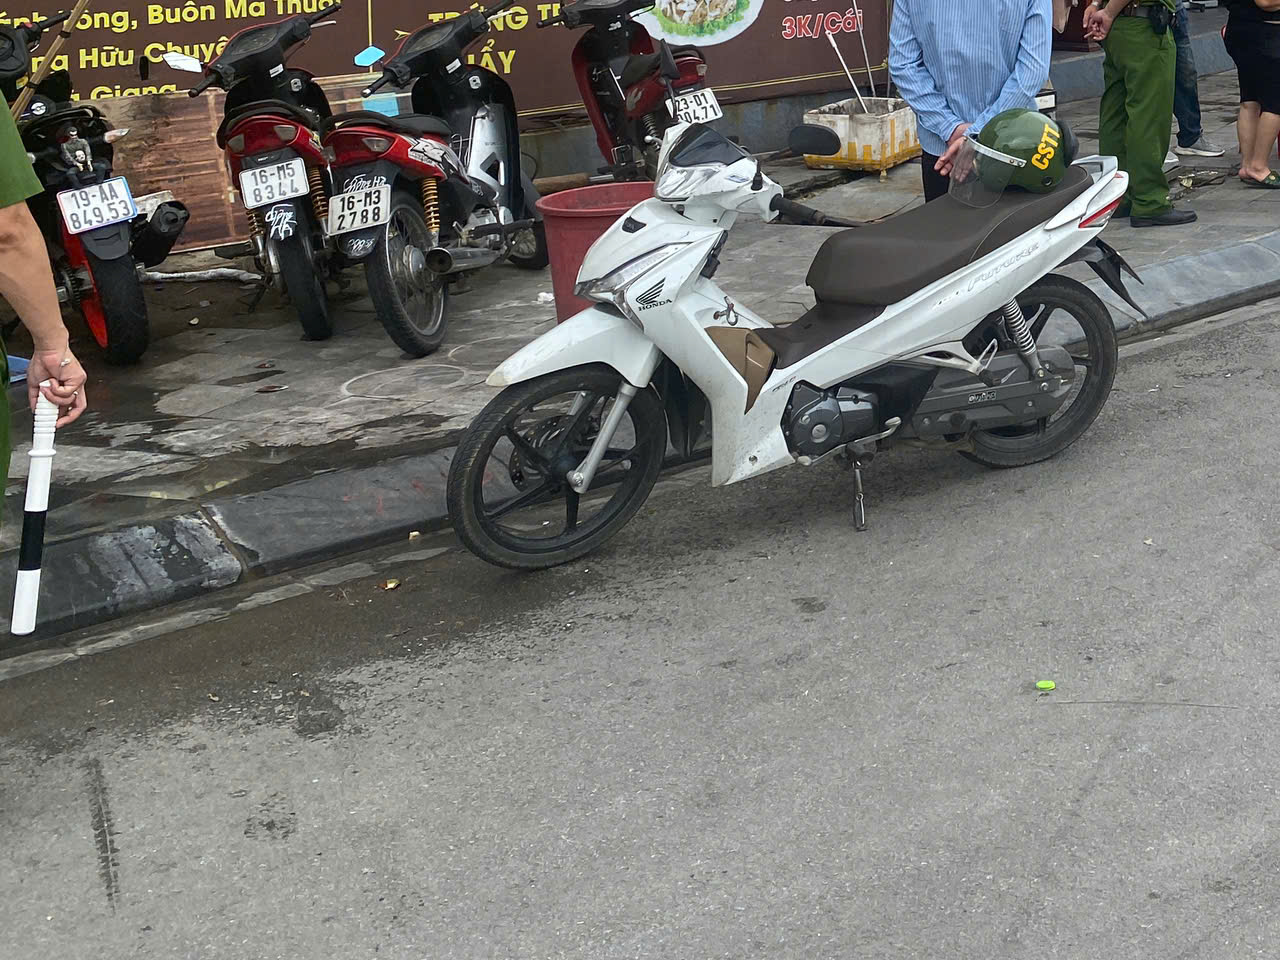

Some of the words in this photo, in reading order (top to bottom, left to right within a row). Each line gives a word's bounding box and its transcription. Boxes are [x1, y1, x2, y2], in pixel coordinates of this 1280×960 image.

[147, 0, 216, 25] Buôn
[79, 44, 134, 69] Hữu
[674, 93, 709, 112] 23-01
[1031, 123, 1060, 170] CSTT
[250, 163, 296, 186] 16-M5
[71, 183, 119, 209] 19-AA
[253, 179, 300, 203] 8344
[340, 189, 381, 212] 16-M3
[70, 200, 131, 230] 849.53
[337, 206, 381, 231] 2788
[638, 298, 673, 311] HONDA
